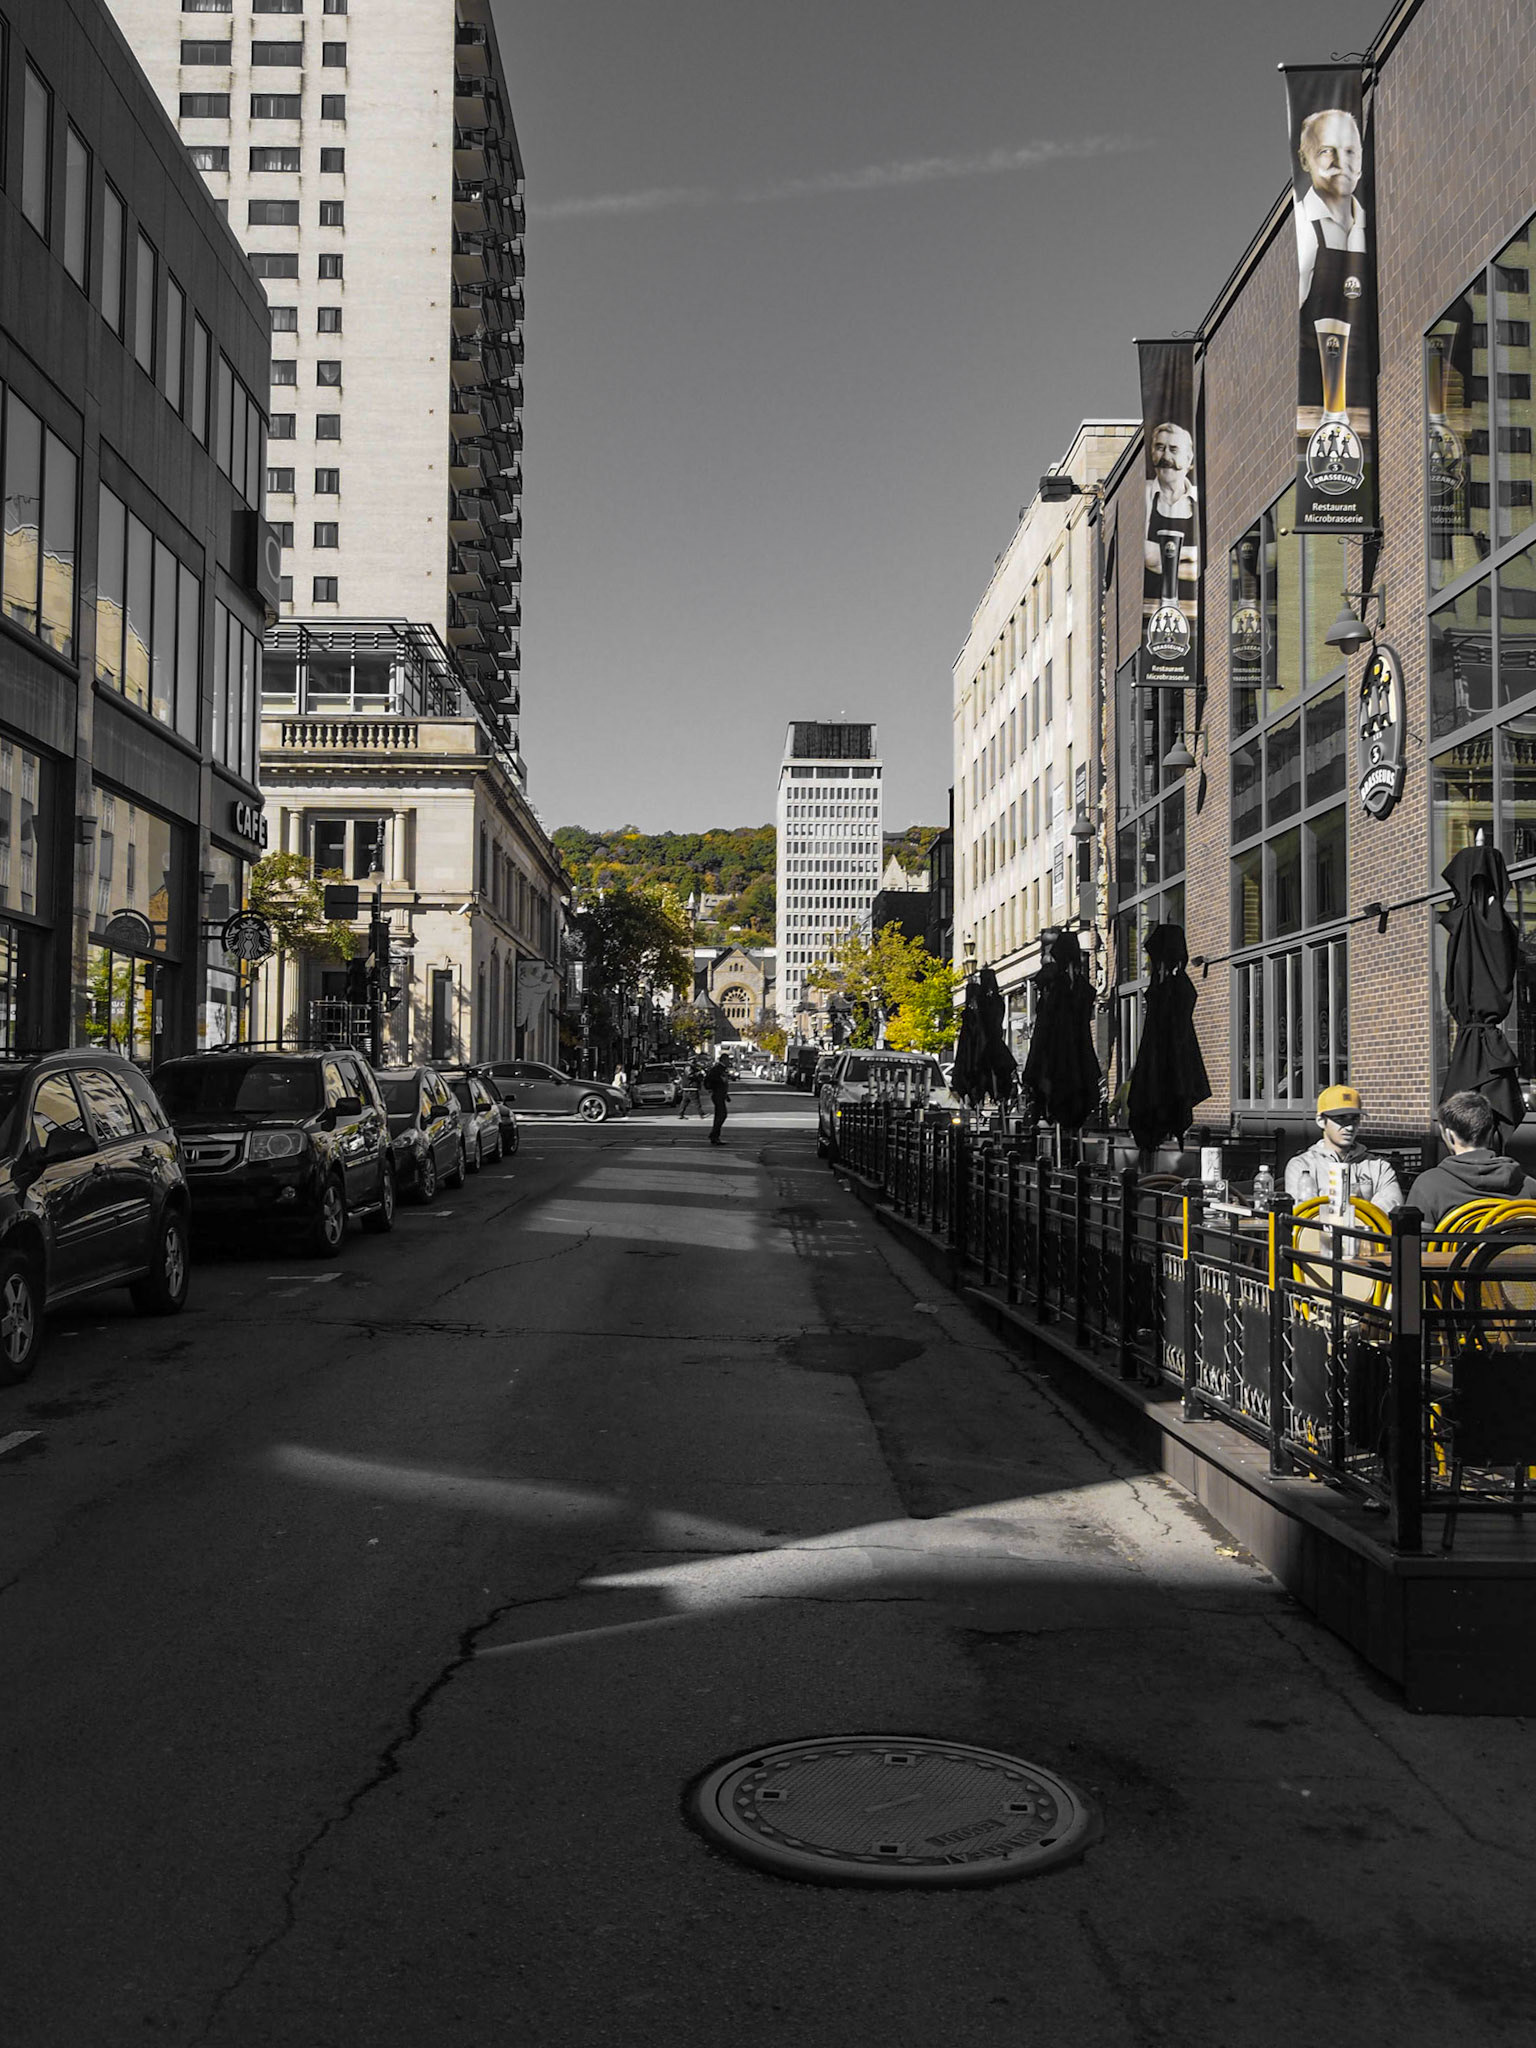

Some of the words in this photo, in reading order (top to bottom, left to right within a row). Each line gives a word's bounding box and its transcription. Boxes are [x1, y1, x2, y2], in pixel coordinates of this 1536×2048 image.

[1313, 474, 1357, 485] BRASSEURS
[1312, 502, 1357, 511] Restaurant
[1304, 514, 1364, 523] Microbrasserie
[1151, 664, 1185, 673] Restaurant
[1145, 673, 1190, 681] Microbrasserie
[1372, 746, 1380, 764] 3
[1361, 769, 1395, 801] BRASSEURS
